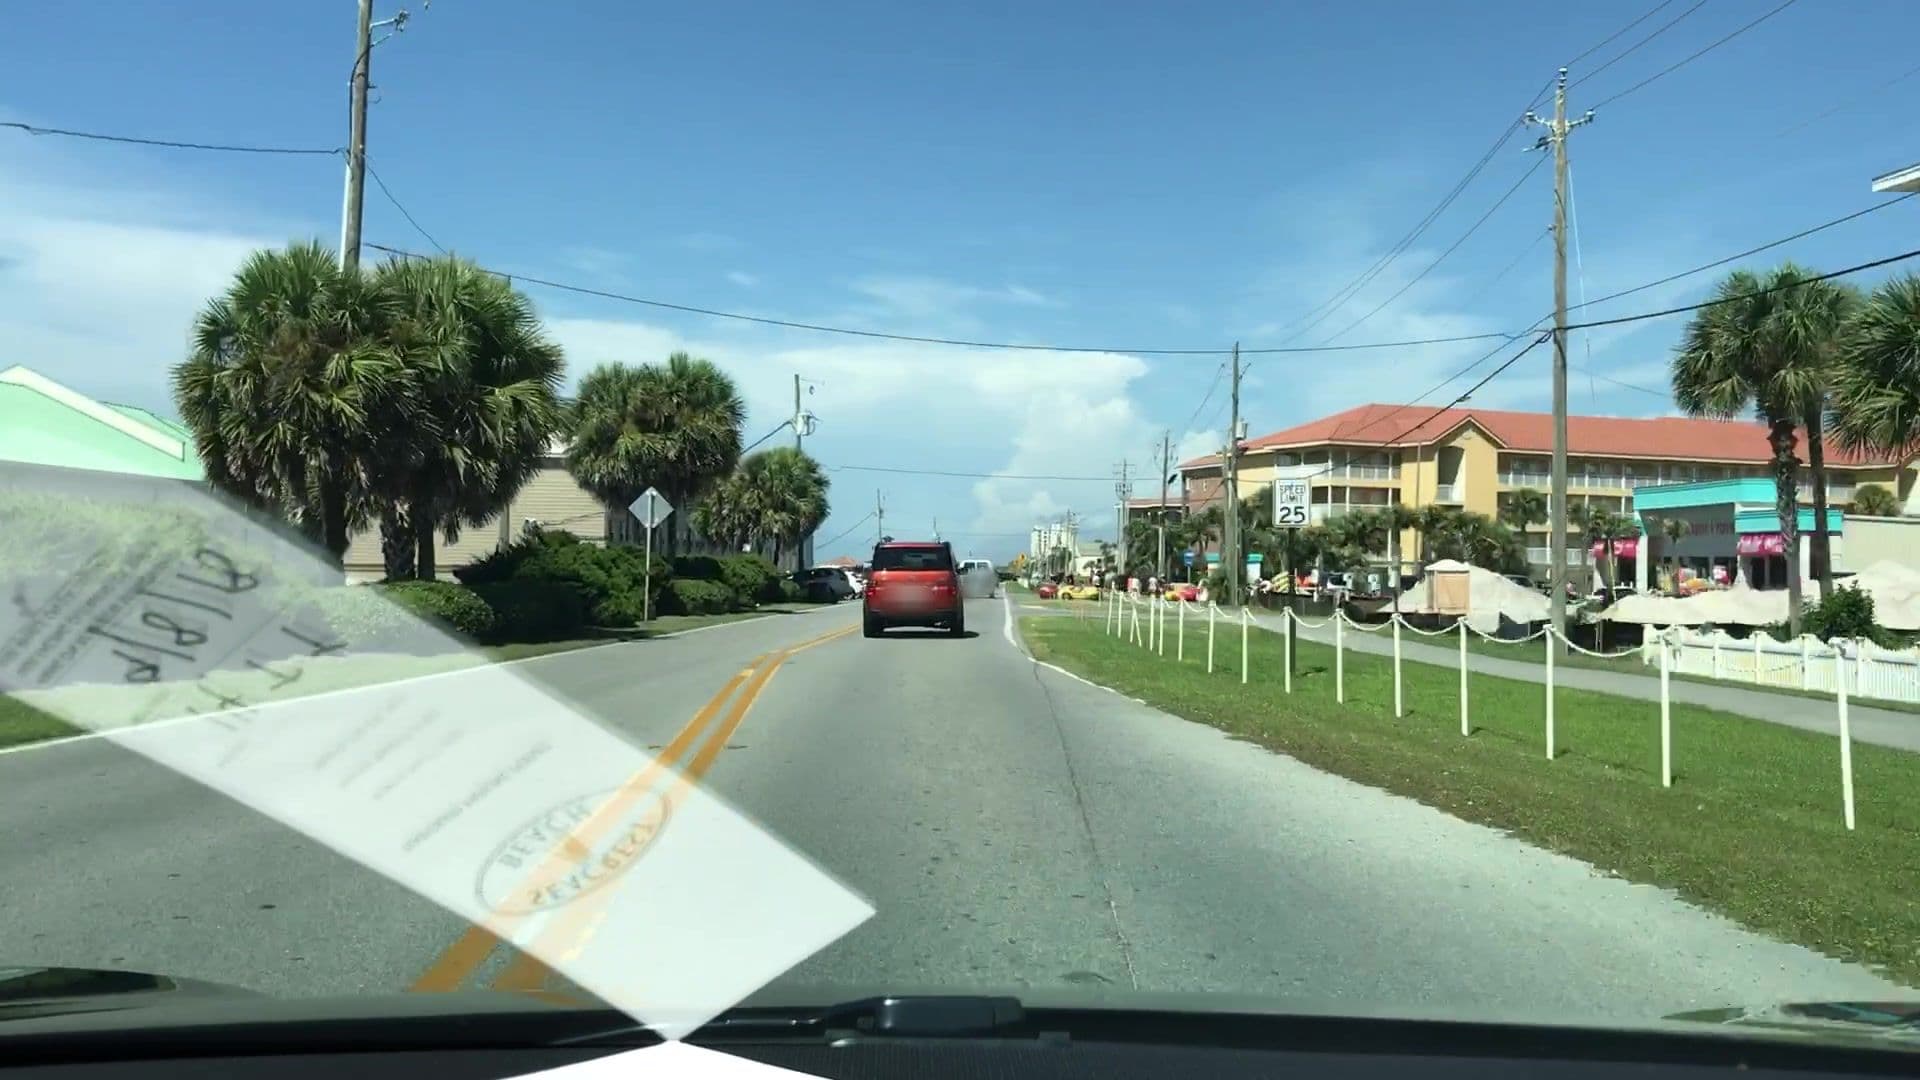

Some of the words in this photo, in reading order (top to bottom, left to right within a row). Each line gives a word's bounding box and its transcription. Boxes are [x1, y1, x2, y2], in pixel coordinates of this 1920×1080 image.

[1279, 485, 1305, 494] SPEED
[1280, 494, 1304, 504] LIMIT
[1279, 506, 1306, 524] 25
